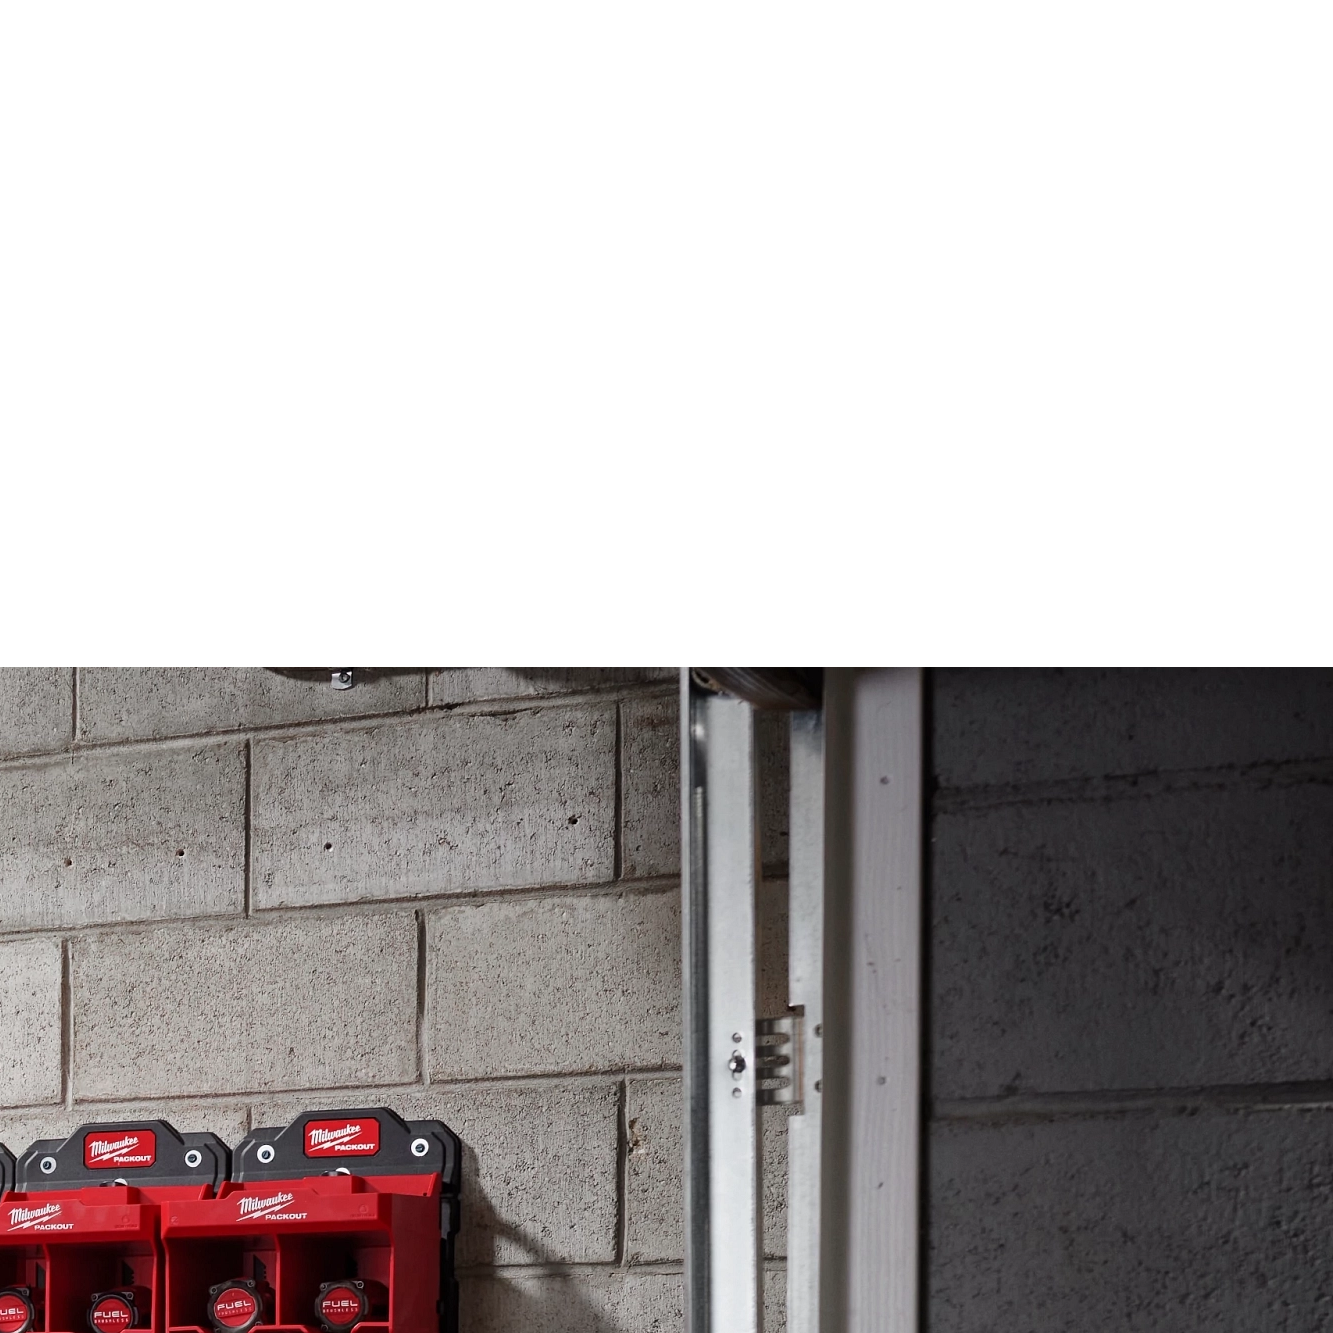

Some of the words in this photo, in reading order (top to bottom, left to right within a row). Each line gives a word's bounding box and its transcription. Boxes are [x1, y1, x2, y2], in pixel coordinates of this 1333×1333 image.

[308, 1124, 361, 1145] Milwaukee
[88, 1136, 139, 1158] Milwaukee
[334, 1143, 375, 1151] PACKOUT
[237, 1192, 293, 1214] Milwaukee
[8, 1203, 61, 1225] Milwaukee
[265, 1212, 307, 1220] PACKOUT
[33, 1223, 74, 1231] PACKOUT
[217, 1299, 251, 1311] FUEL
[322, 1300, 358, 1308] FUEL
[94, 1311, 128, 1319] FUEL
